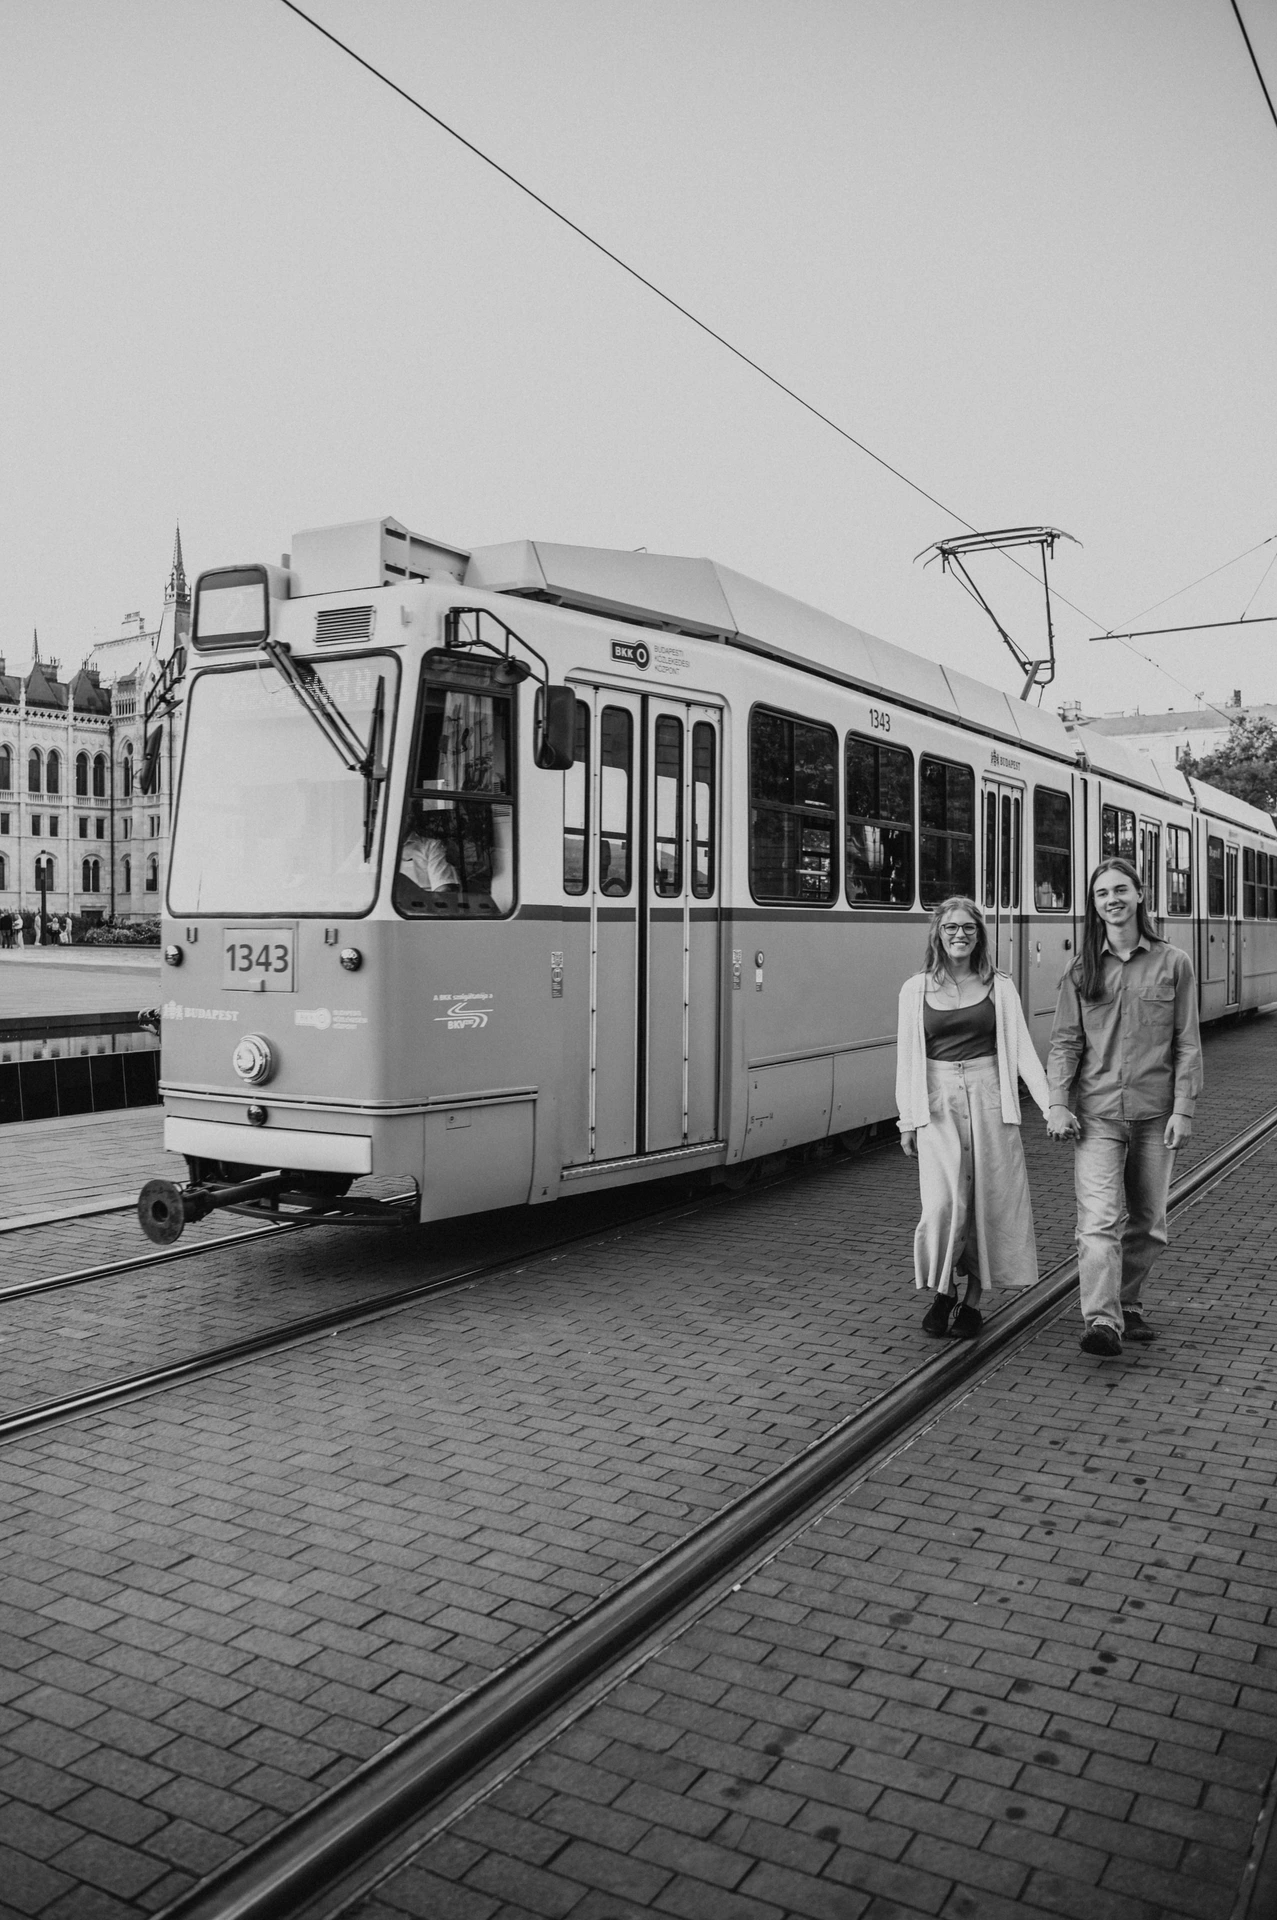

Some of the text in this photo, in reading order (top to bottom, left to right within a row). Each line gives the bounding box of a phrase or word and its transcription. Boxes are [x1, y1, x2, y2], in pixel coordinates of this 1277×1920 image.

[615, 646, 634, 659] BKK
[869, 708, 891, 732] 1343
[1000, 756, 1021, 771] BUDAPEST
[226, 944, 289, 973] 1343
[184, 1007, 240, 1022] BUDAPEST
